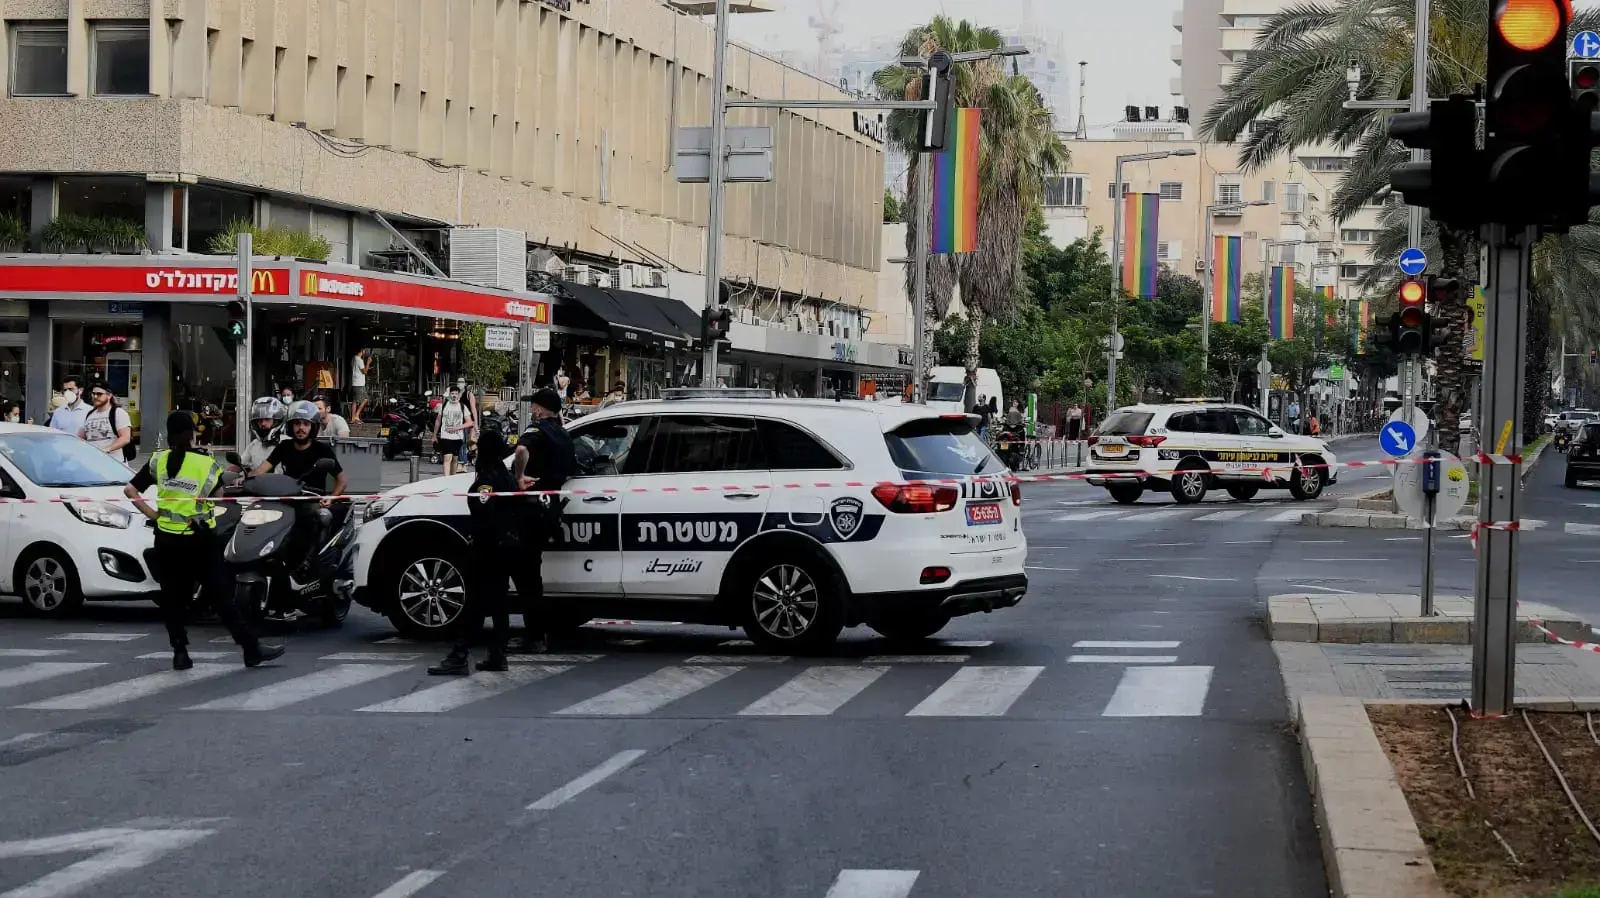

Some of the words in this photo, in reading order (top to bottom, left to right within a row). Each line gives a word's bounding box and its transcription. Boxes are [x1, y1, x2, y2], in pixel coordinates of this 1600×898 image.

[559, 521, 601, 544] ישר
[637, 520, 738, 543] משטרת
[583, 559, 593, 572] C
